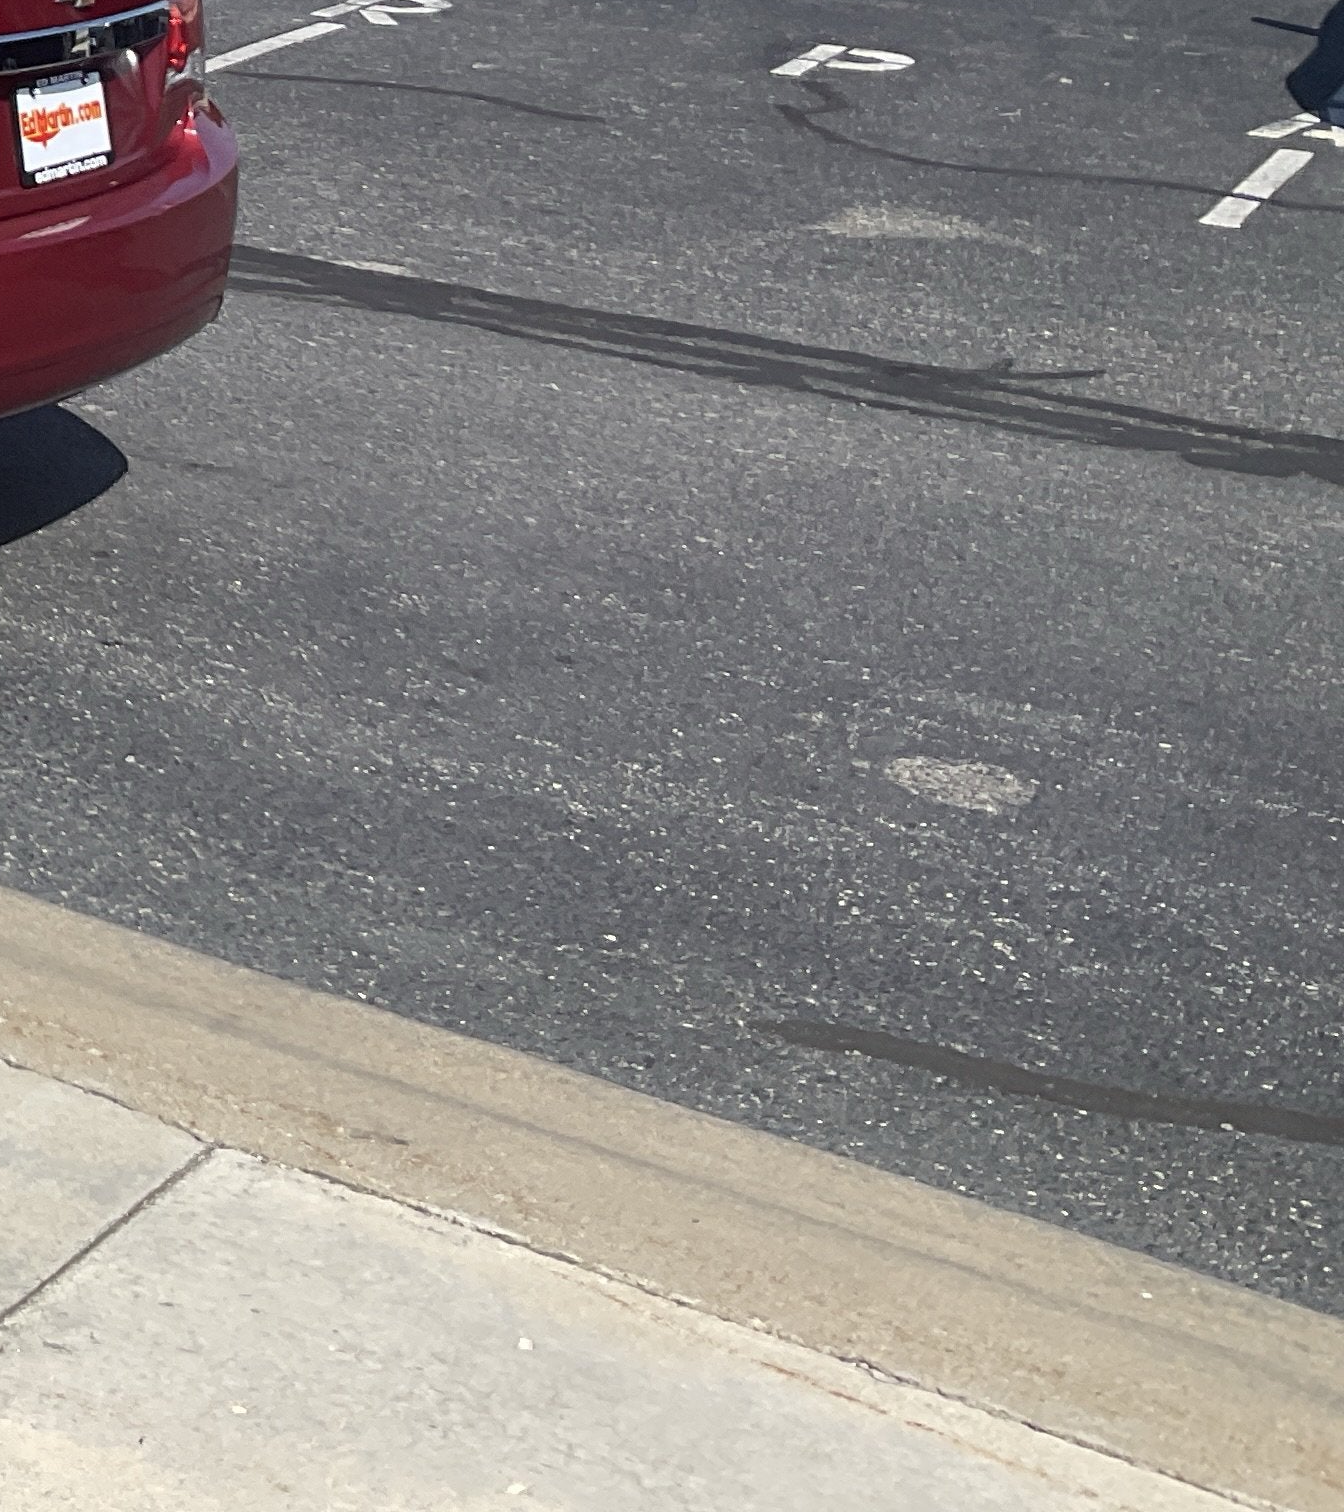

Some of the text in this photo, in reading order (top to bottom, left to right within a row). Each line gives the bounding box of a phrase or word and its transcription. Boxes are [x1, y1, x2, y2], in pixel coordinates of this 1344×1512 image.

[769, 44, 916, 76] P
[21, 100, 102, 137] EdMartin.com
[34, 155, 108, 184] edmartin.com
